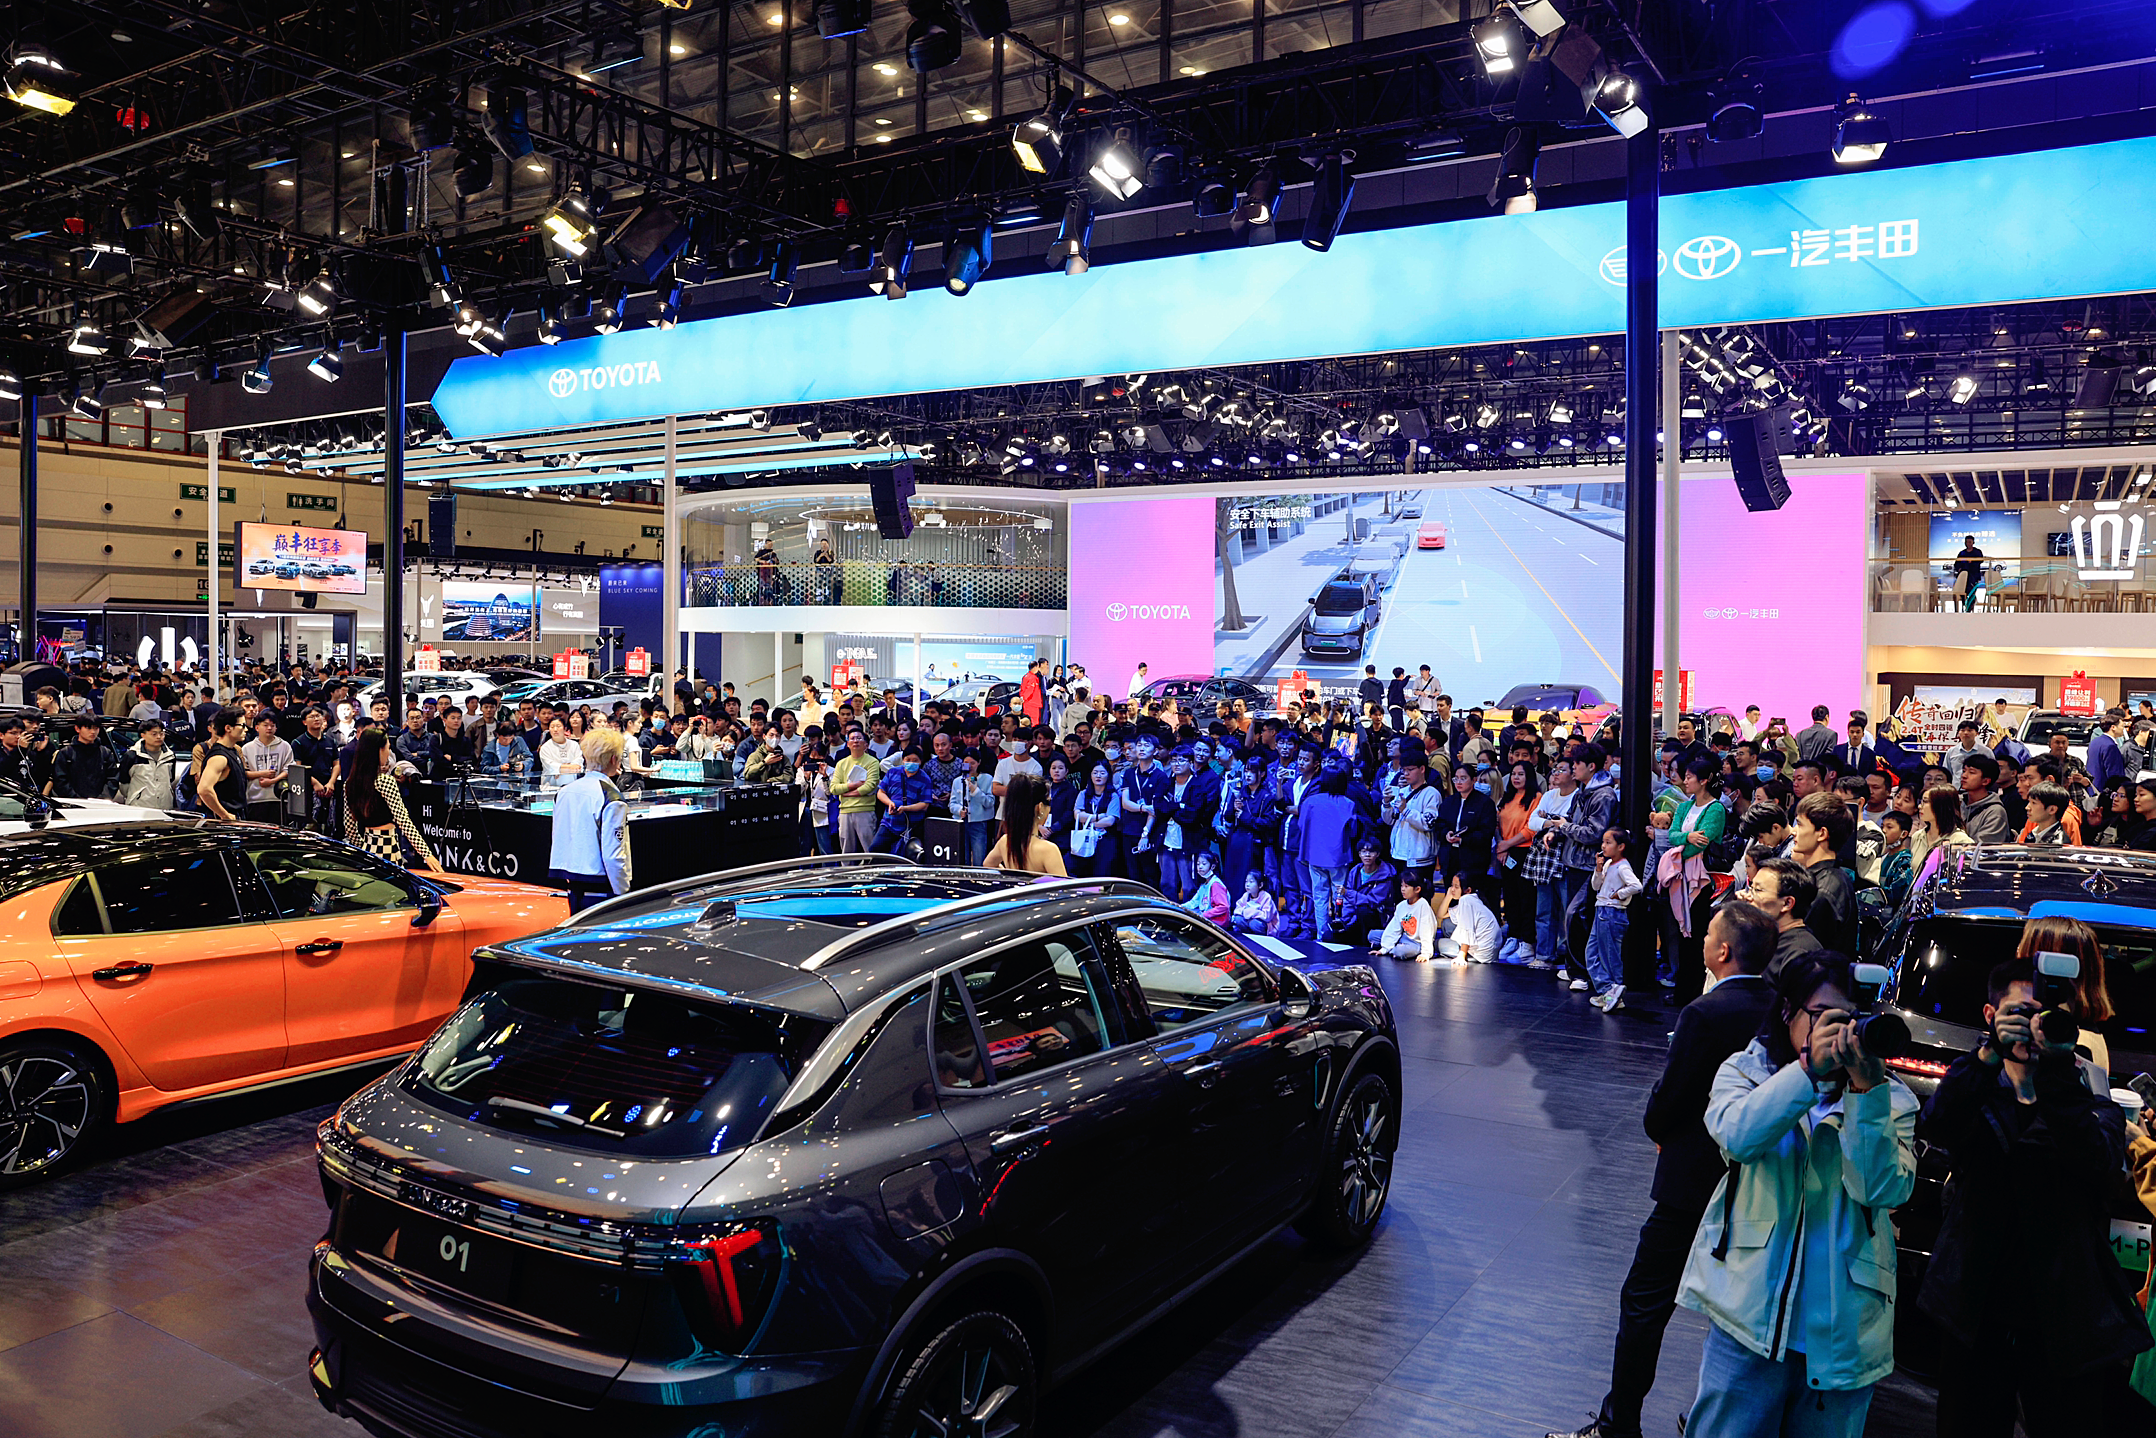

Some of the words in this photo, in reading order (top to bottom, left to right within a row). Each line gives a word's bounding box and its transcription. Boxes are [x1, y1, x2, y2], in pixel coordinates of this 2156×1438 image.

[1751, 218, 1918, 268] 一汽丰田
[579, 360, 661, 391] TOYOTA
[188, 486, 228, 498] 安全道
[305, 496, 335, 507] 洗手间
[1230, 506, 1311, 520] 安全下车辅助系统
[1230, 520, 1248, 529] Safe
[1249, 520, 1264, 529] Exit
[1267, 519, 1291, 528] Assist
[272, 531, 342, 555] 巅丰狂享季
[1130, 604, 1191, 619] TOYOTA
[1741, 608, 1779, 619] 一汽丰田
[1896, 696, 1975, 724] 传奇回归
[175, 724, 190, 732] STAFF
[1902, 726, 1924, 734] 2.4T
[1924, 724, 1953, 732] 全时四驱
[291, 784, 301, 795] 03
[423, 804, 432, 817] Hi
[423, 823, 462, 839] Welcome
[463, 829, 472, 840] to
[933, 844, 950, 860] 01
[424, 843, 518, 877] YNK&CO
[440, 1234, 470, 1273] 01
